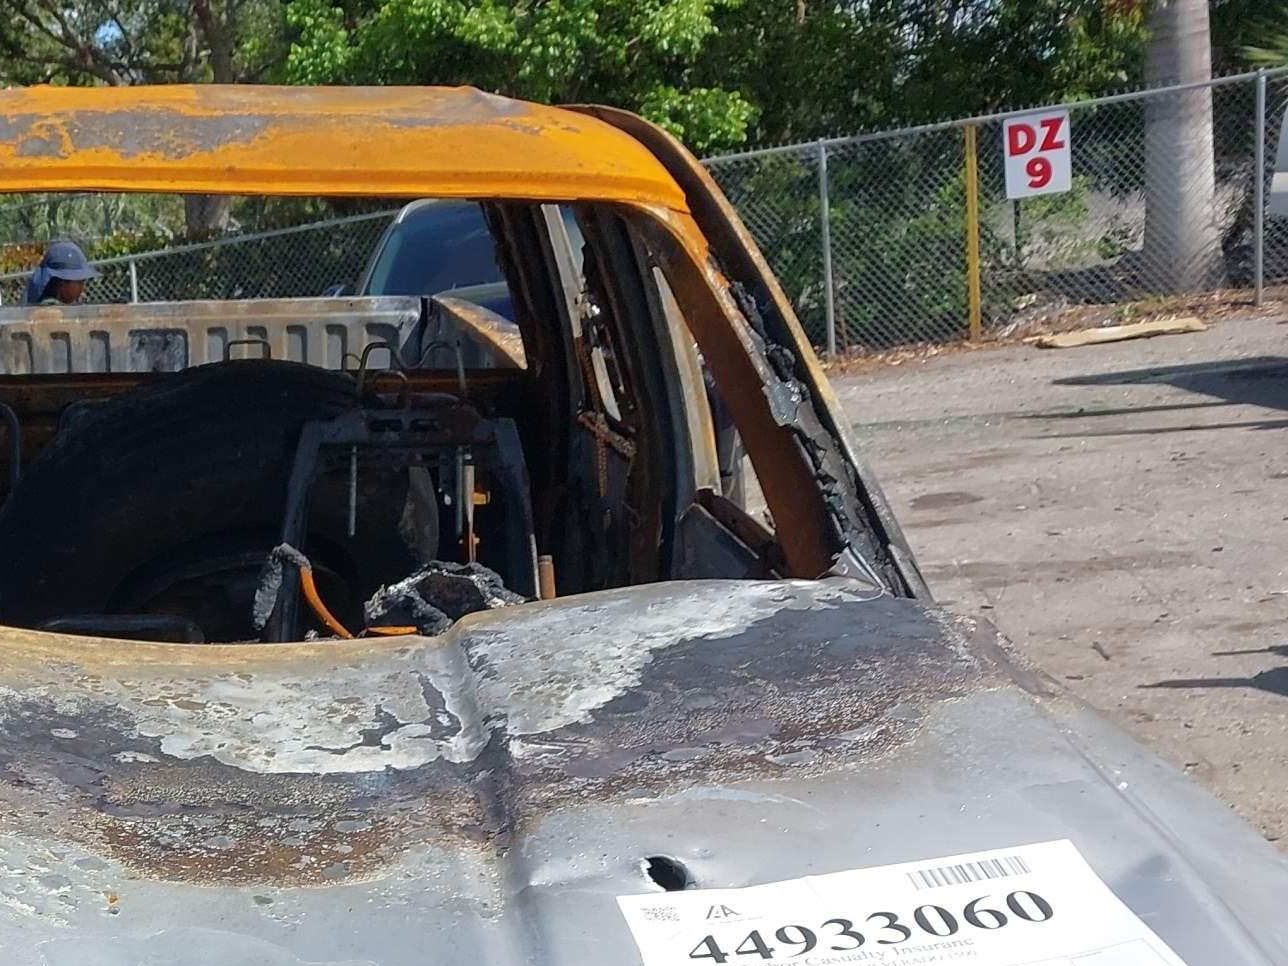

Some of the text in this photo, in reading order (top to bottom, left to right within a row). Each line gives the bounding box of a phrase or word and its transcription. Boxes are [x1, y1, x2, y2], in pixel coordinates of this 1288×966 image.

[1008, 116, 1066, 157] DZ
[1026, 156, 1053, 189] 9
[688, 890, 1054, 964] 44933060
